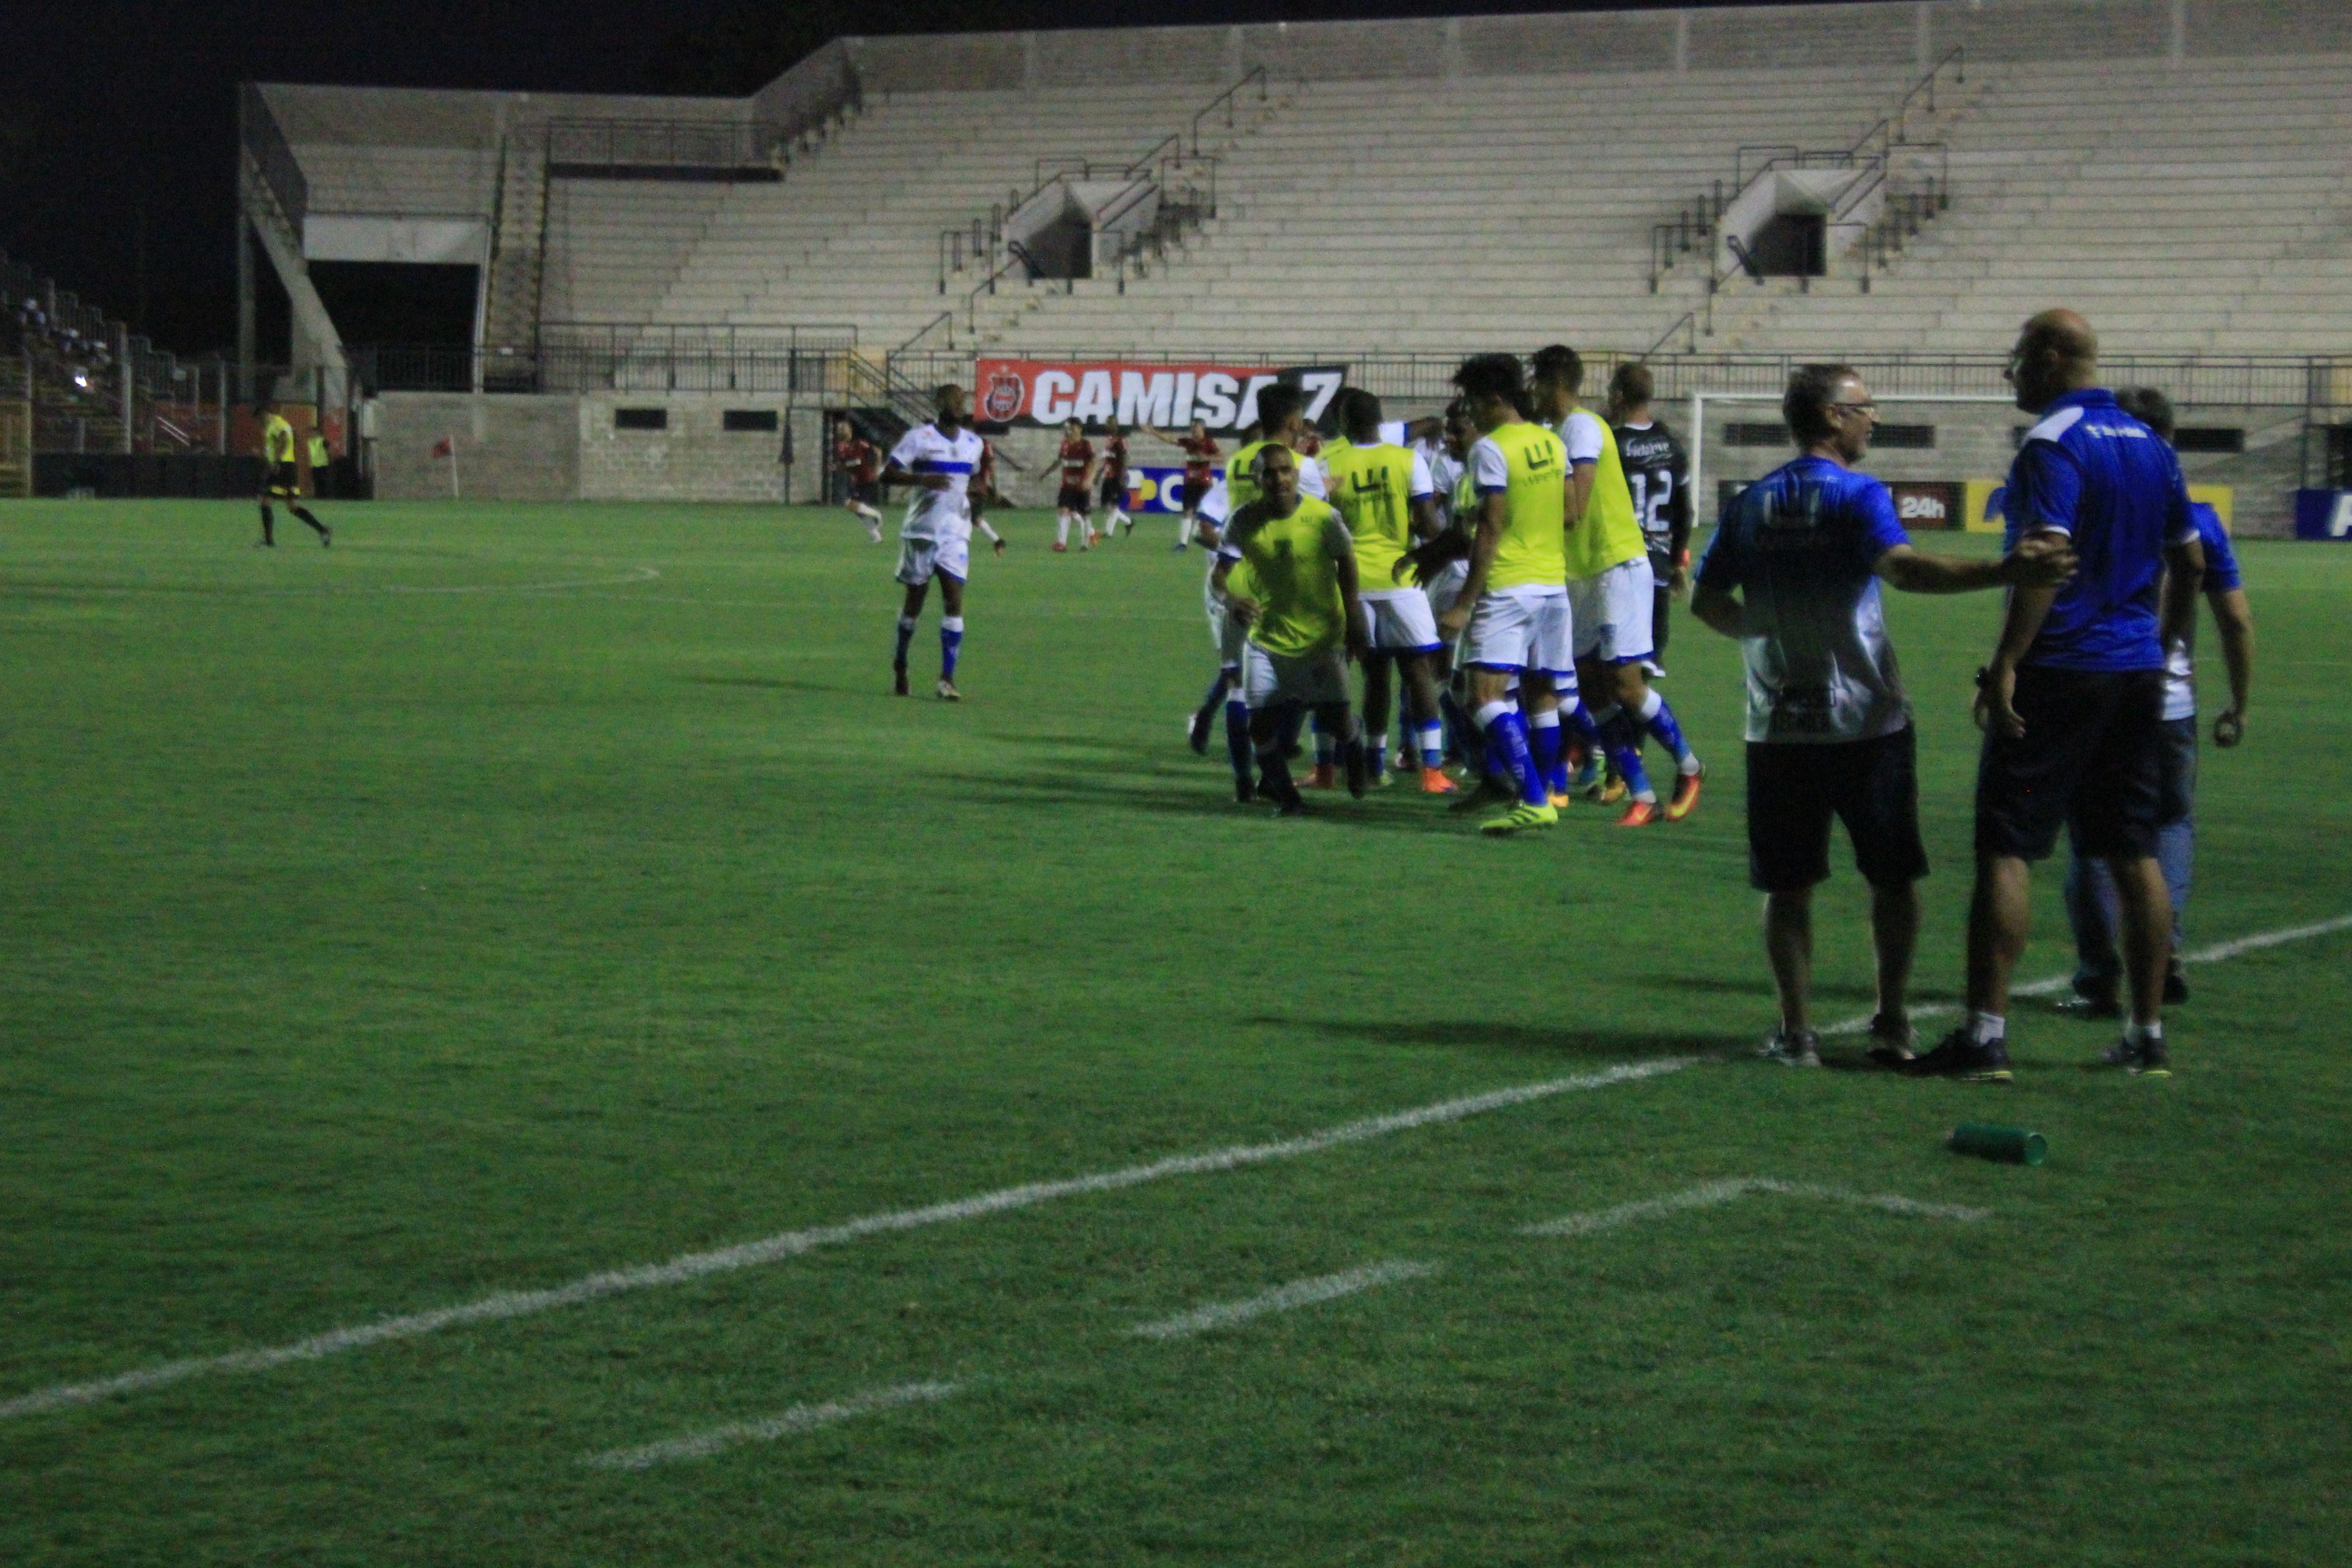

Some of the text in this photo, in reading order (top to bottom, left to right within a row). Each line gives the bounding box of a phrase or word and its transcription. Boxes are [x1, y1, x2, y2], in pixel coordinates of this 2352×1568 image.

[1301, 372, 1342, 424] 7
[1632, 469, 1672, 533] 12
[1900, 495, 1945, 519] 24h
